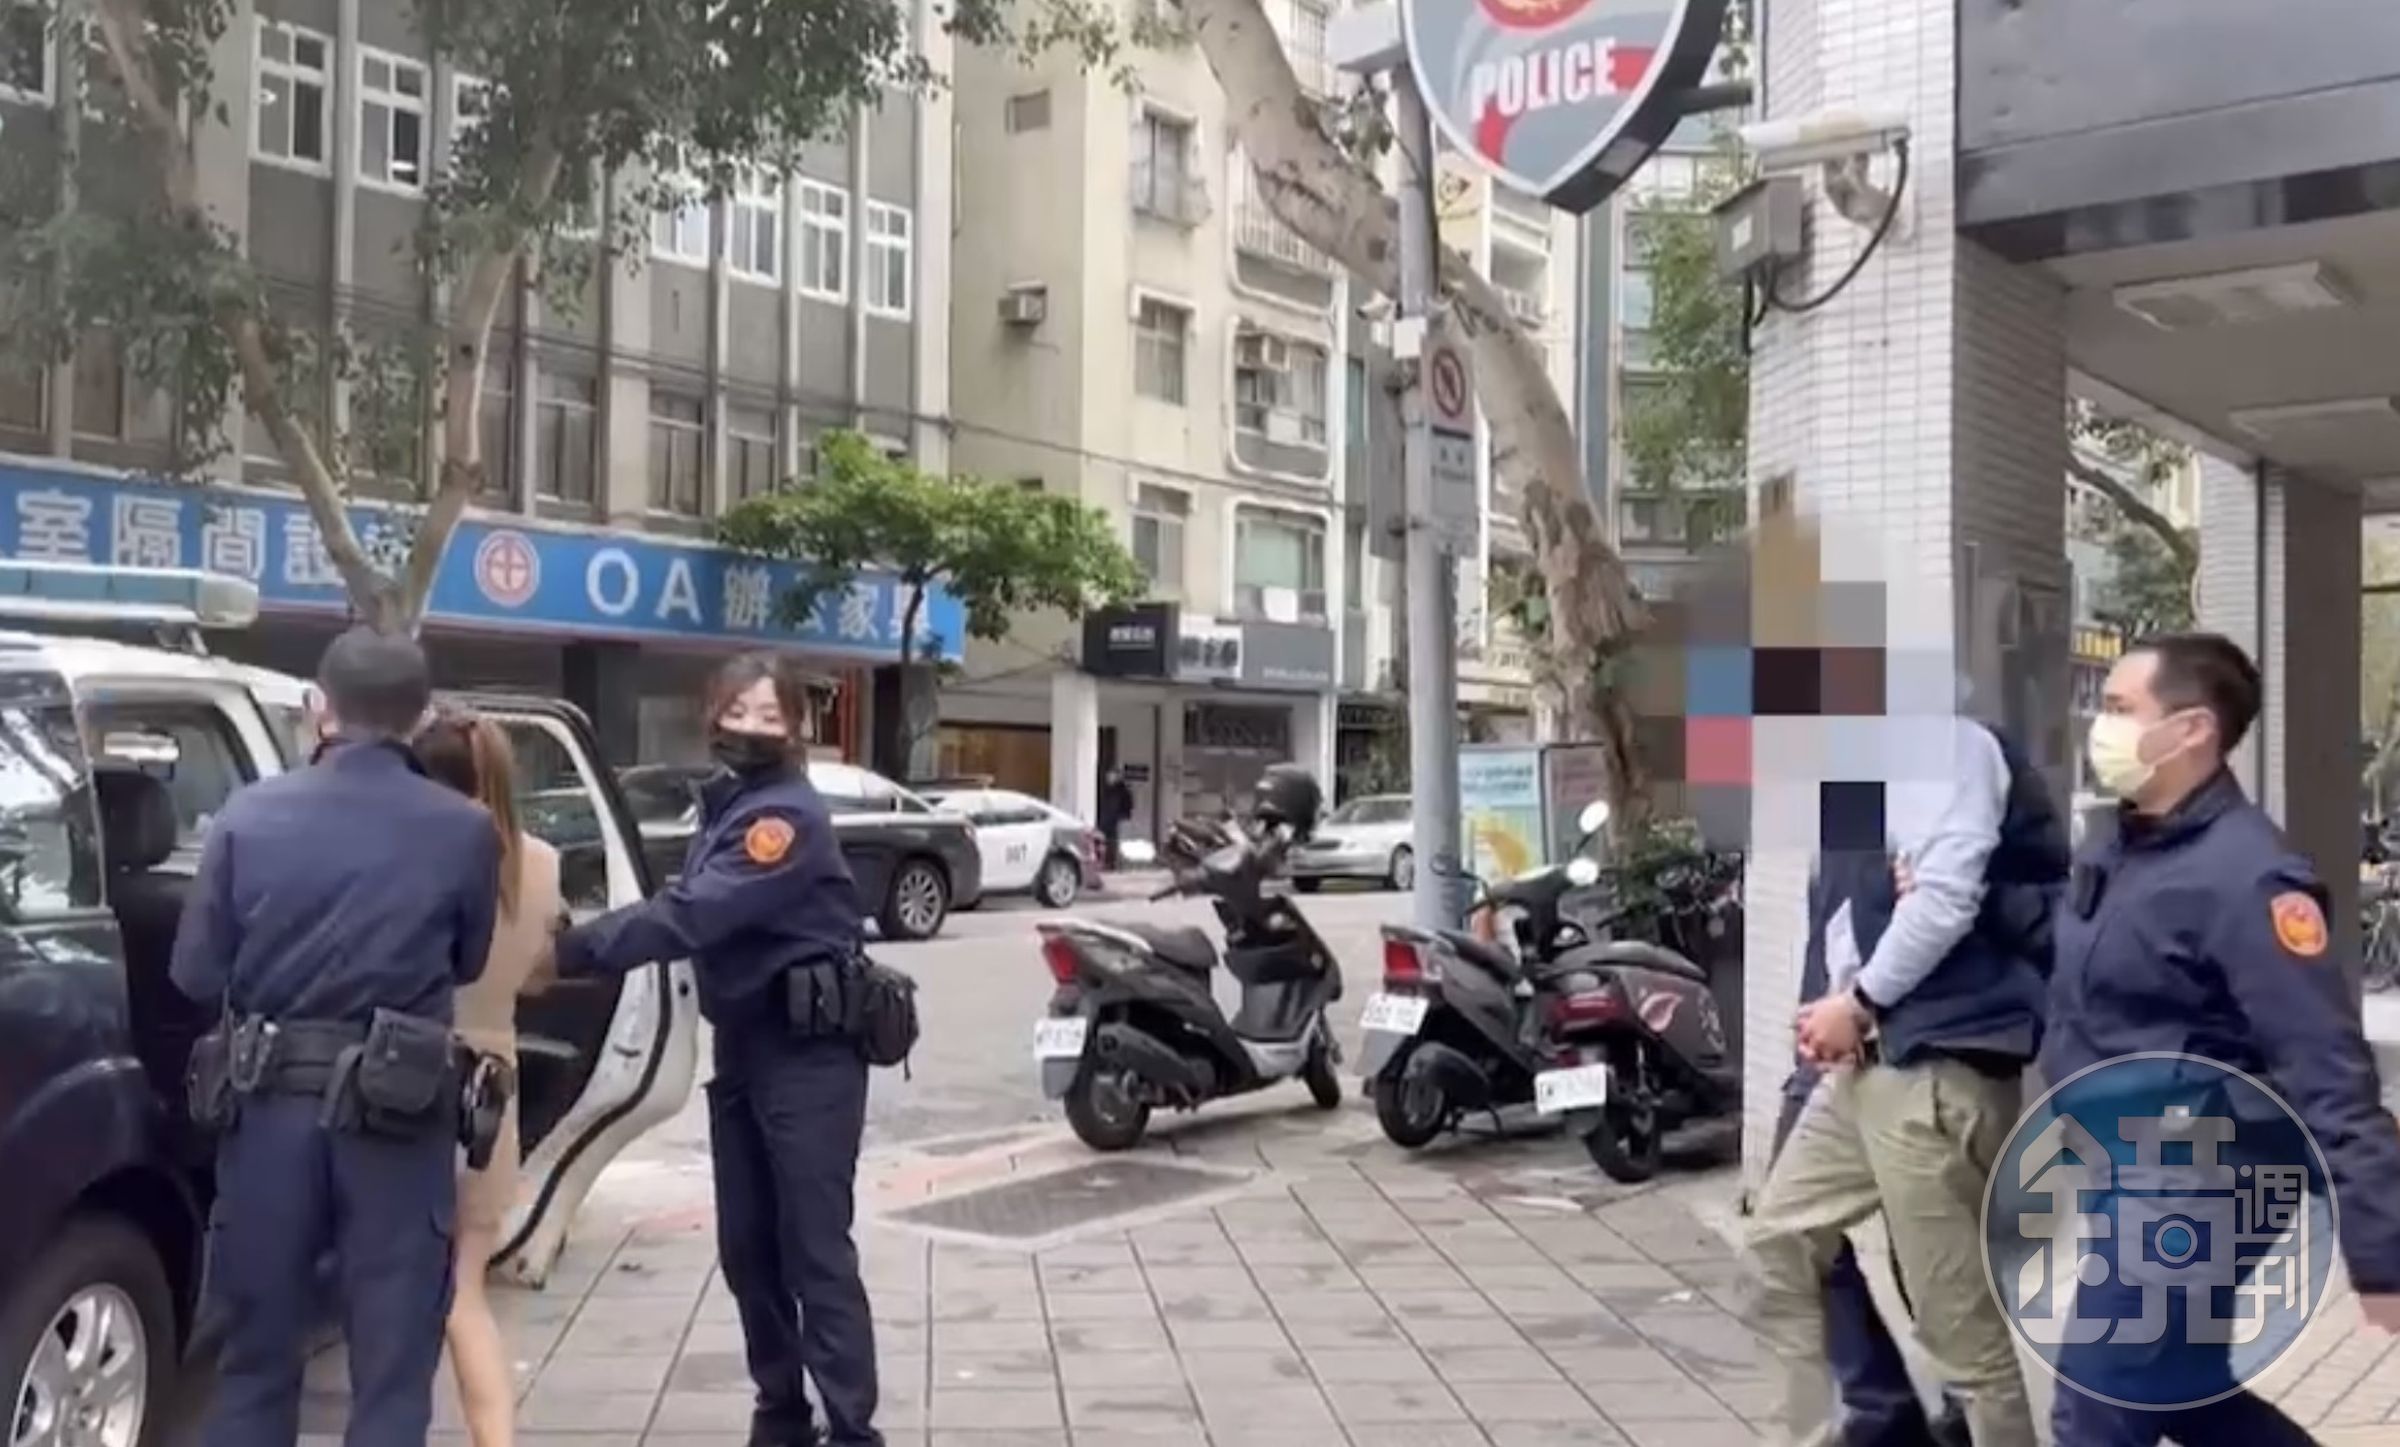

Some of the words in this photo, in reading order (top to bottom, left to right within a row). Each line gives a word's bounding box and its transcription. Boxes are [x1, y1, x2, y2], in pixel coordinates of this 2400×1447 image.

[1471, 36, 1617, 122] POLICE
[15, 489, 412, 585] 室隔間設
[585, 547, 703, 622] OA
